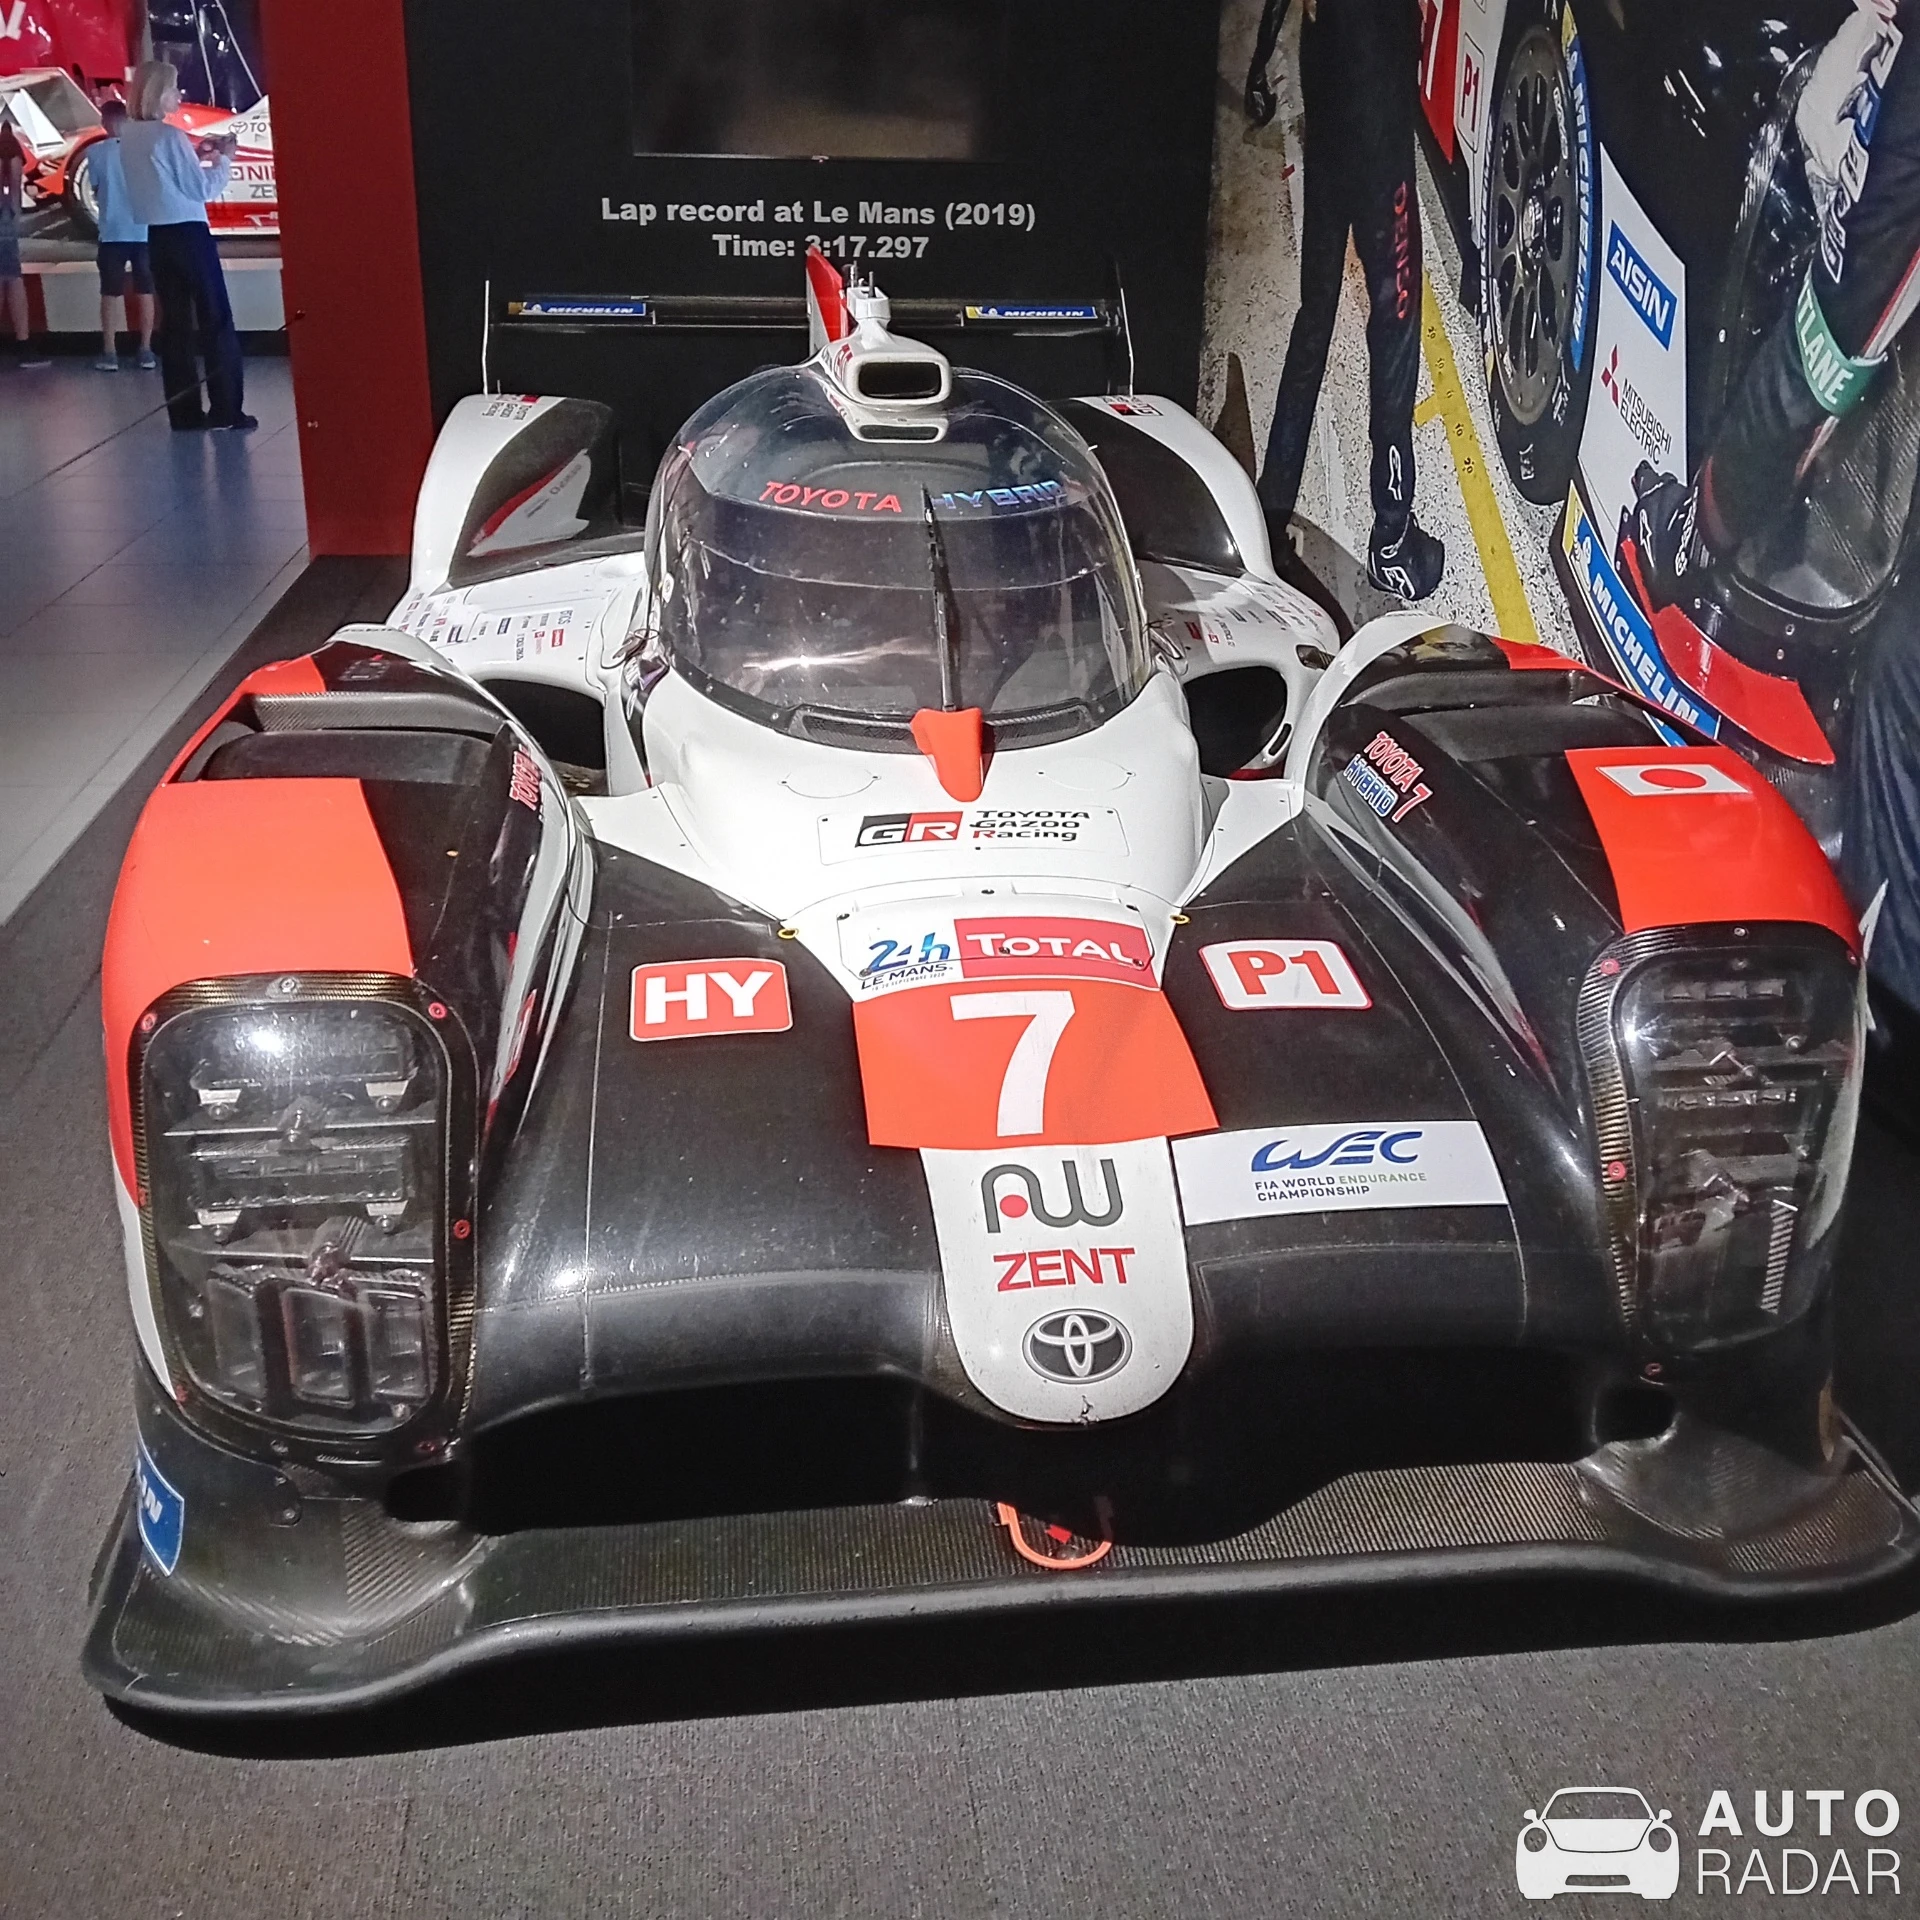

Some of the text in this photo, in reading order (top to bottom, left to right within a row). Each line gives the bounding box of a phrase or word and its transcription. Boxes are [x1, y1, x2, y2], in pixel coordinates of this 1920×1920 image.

[250, 122, 270, 133] TO
[248, 165, 275, 181] NI
[249, 184, 277, 199] ZE
[602, 198, 1035, 231] Lap record at Le Mans (2019)
[712, 234, 796, 257] Time:
[1611, 240, 1670, 331] AISIN
[1620, 398, 1661, 465] ELECTRIC
[1622, 378, 1672, 454] MITSUBISHI
[758, 481, 902, 513] TOYOTA
[1592, 573, 1699, 726] MICHELIN
[1363, 731, 1424, 793] TOYOTA
[1343, 753, 1399, 817] HYBRID
[976, 810, 1090, 819] TOYOTA
[1391, 782, 1433, 823] 7
[858, 821, 958, 846] GR
[969, 820, 1080, 829] GAZOO
[972, 829, 1077, 842] Racing
[966, 933, 1144, 966] TOTAL
[861, 963, 948, 990] LE MANS
[1226, 950, 1345, 995] P1
[644, 969, 774, 1024] HY
[951, 990, 1076, 1137] 7
[1251, 1131, 1423, 1172] WEC
[1255, 1172, 1428, 1191] FIA WORLD ENDURANCE
[1257, 1185, 1370, 1202] CHAMPIONSHIP
[993, 1248, 1135, 1292] ZENT
